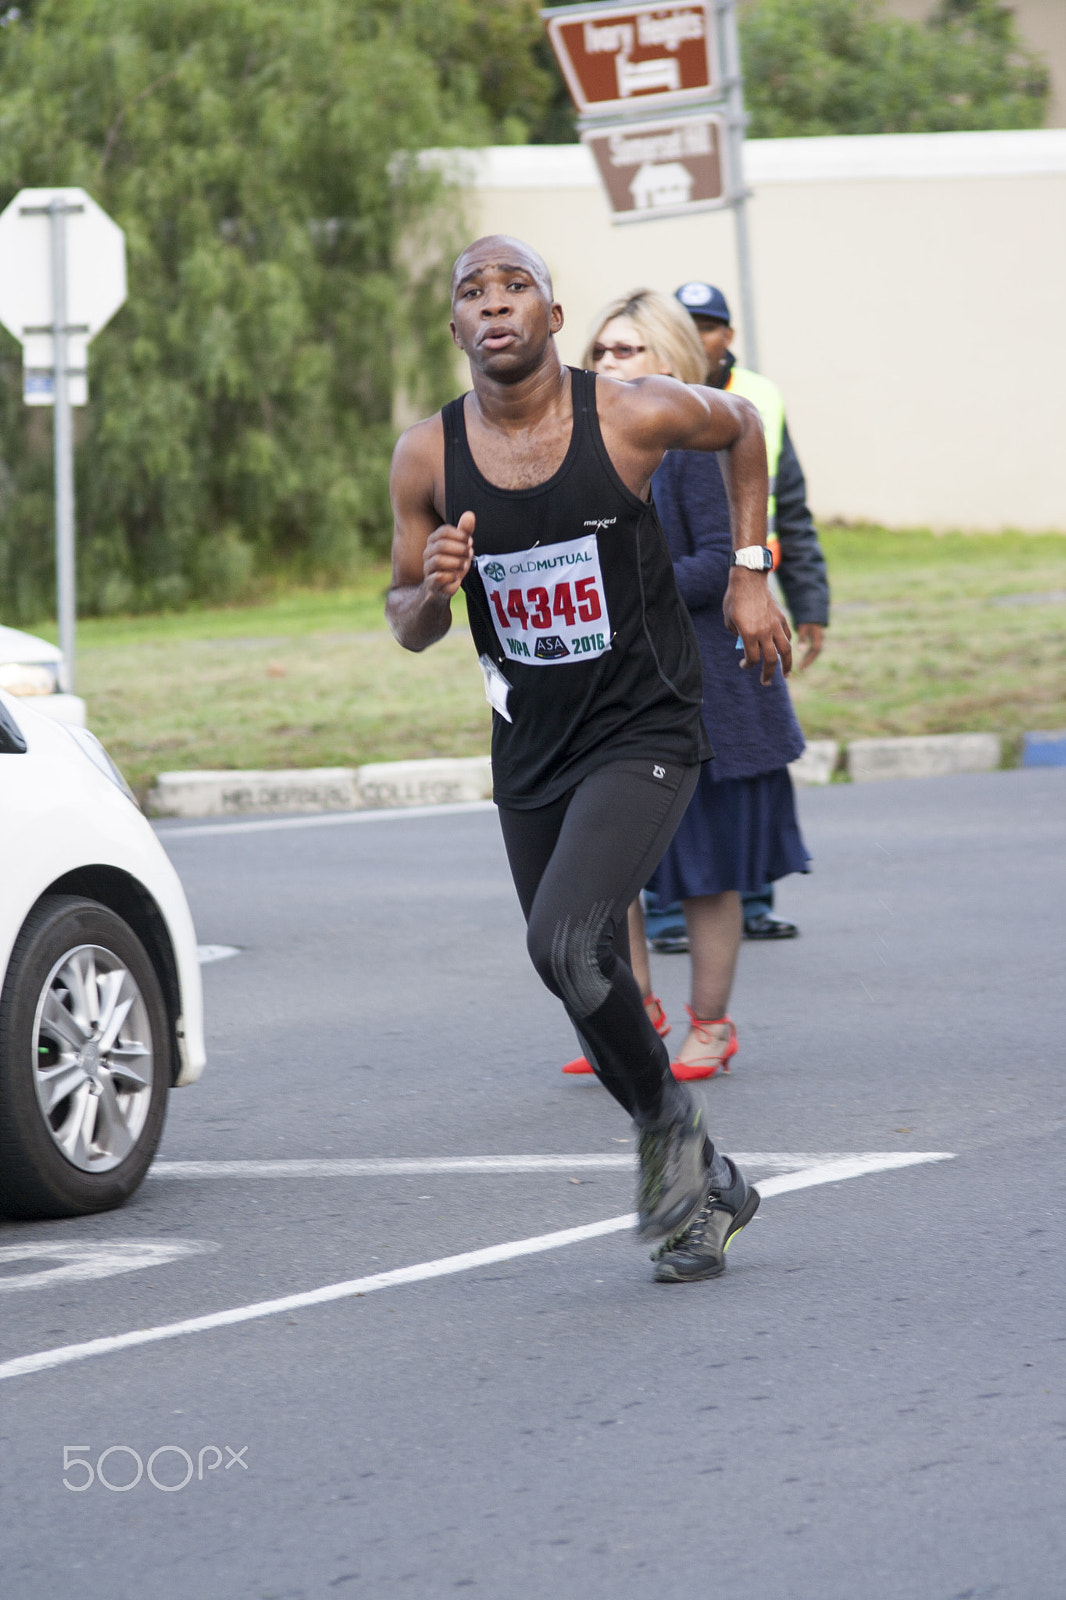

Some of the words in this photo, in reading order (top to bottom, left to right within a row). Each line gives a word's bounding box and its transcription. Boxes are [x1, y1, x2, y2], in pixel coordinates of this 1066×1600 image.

[489, 576, 602, 631] 14345
[506, 637, 531, 658] WPA
[537, 637, 564, 651] ASA
[571, 632, 606, 655] 2016
